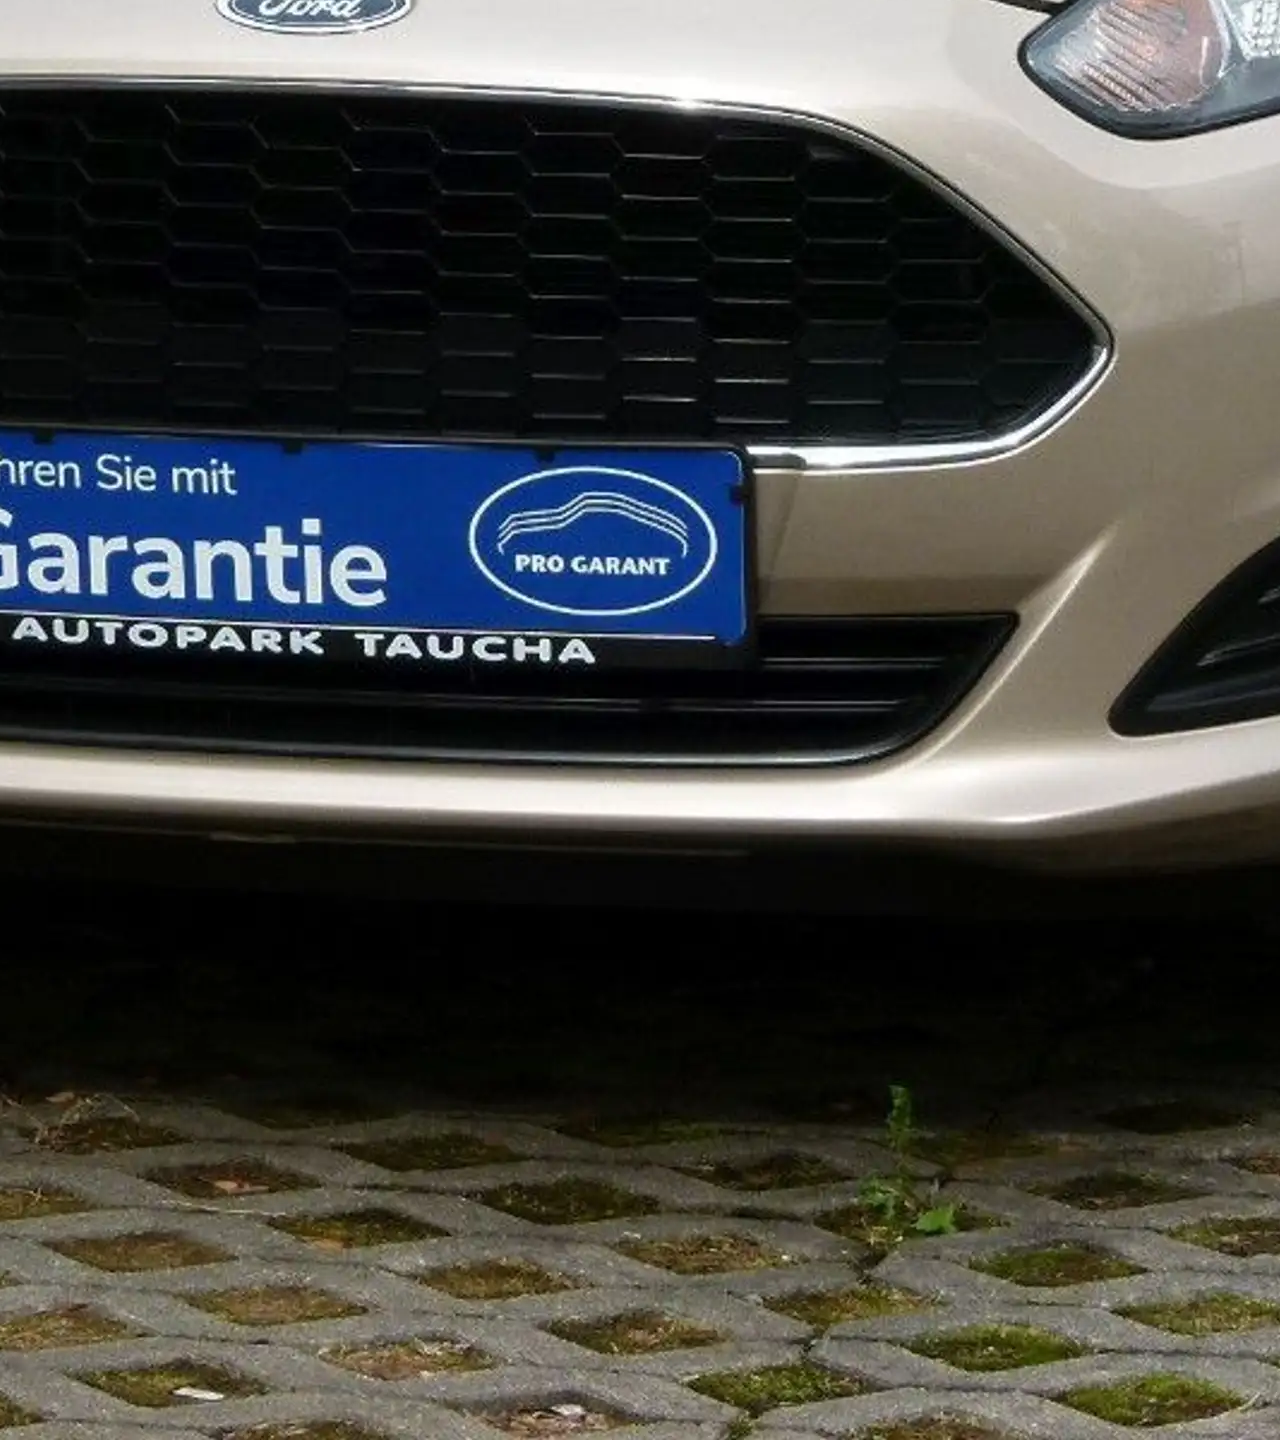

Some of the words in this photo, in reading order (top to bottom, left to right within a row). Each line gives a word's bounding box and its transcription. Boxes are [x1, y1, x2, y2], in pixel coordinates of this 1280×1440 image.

[96, 453, 157, 491] Sie
[171, 458, 238, 495] mit
[514, 554, 564, 573] PRO
[571, 555, 670, 575] GARANT
[12, 616, 325, 655] AUTOPARK
[354, 632, 596, 664] TAUCHA
